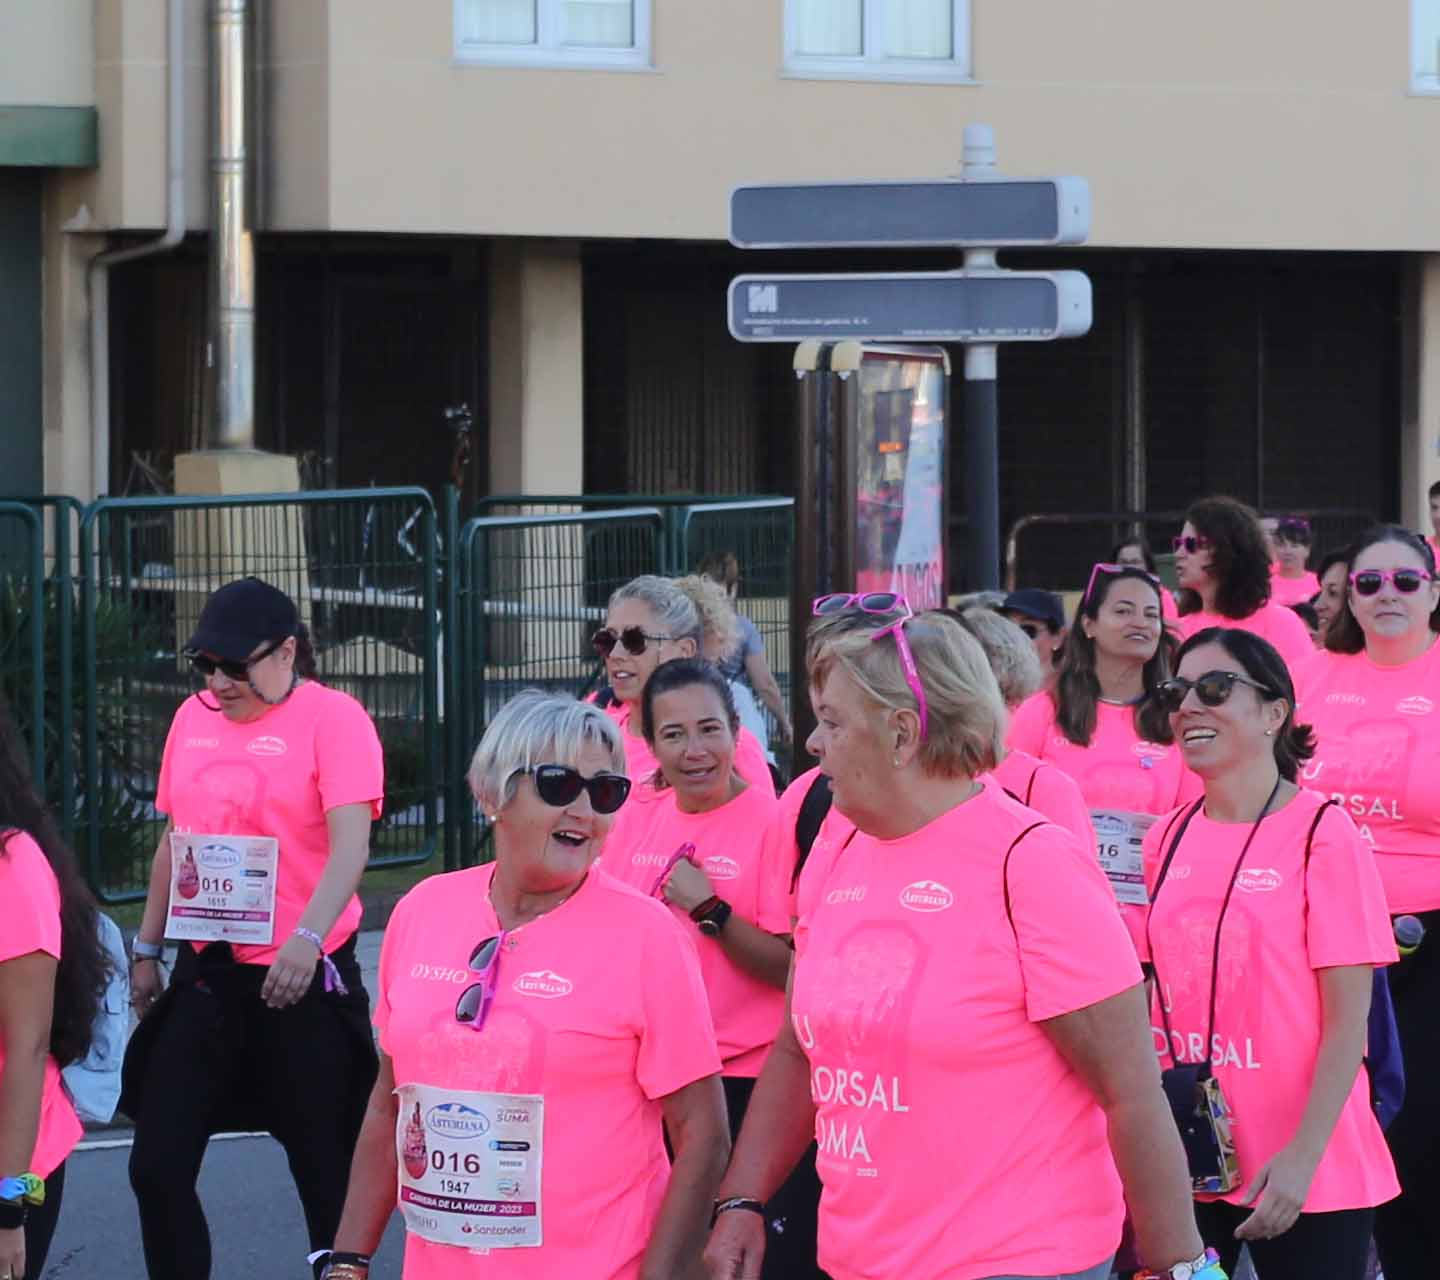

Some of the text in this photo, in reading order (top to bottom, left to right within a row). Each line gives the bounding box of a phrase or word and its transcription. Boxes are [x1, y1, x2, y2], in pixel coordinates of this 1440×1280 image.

[1097, 843, 1118, 857] 16
[202, 877, 233, 893] 016
[410, 962, 469, 984] OYSHO
[811, 1066, 909, 1112] ORSAL
[431, 1113, 484, 1131] ASTURIANA
[432, 1150, 481, 1174] 016
[440, 1179, 470, 1195] 1947
[438, 1199, 450, 1209] DE
[451, 1200, 463, 1210] LA
[464, 1201, 497, 1213] MUJER
[498, 1204, 522, 1214] 2023
[472, 1222, 527, 1236] Santander
